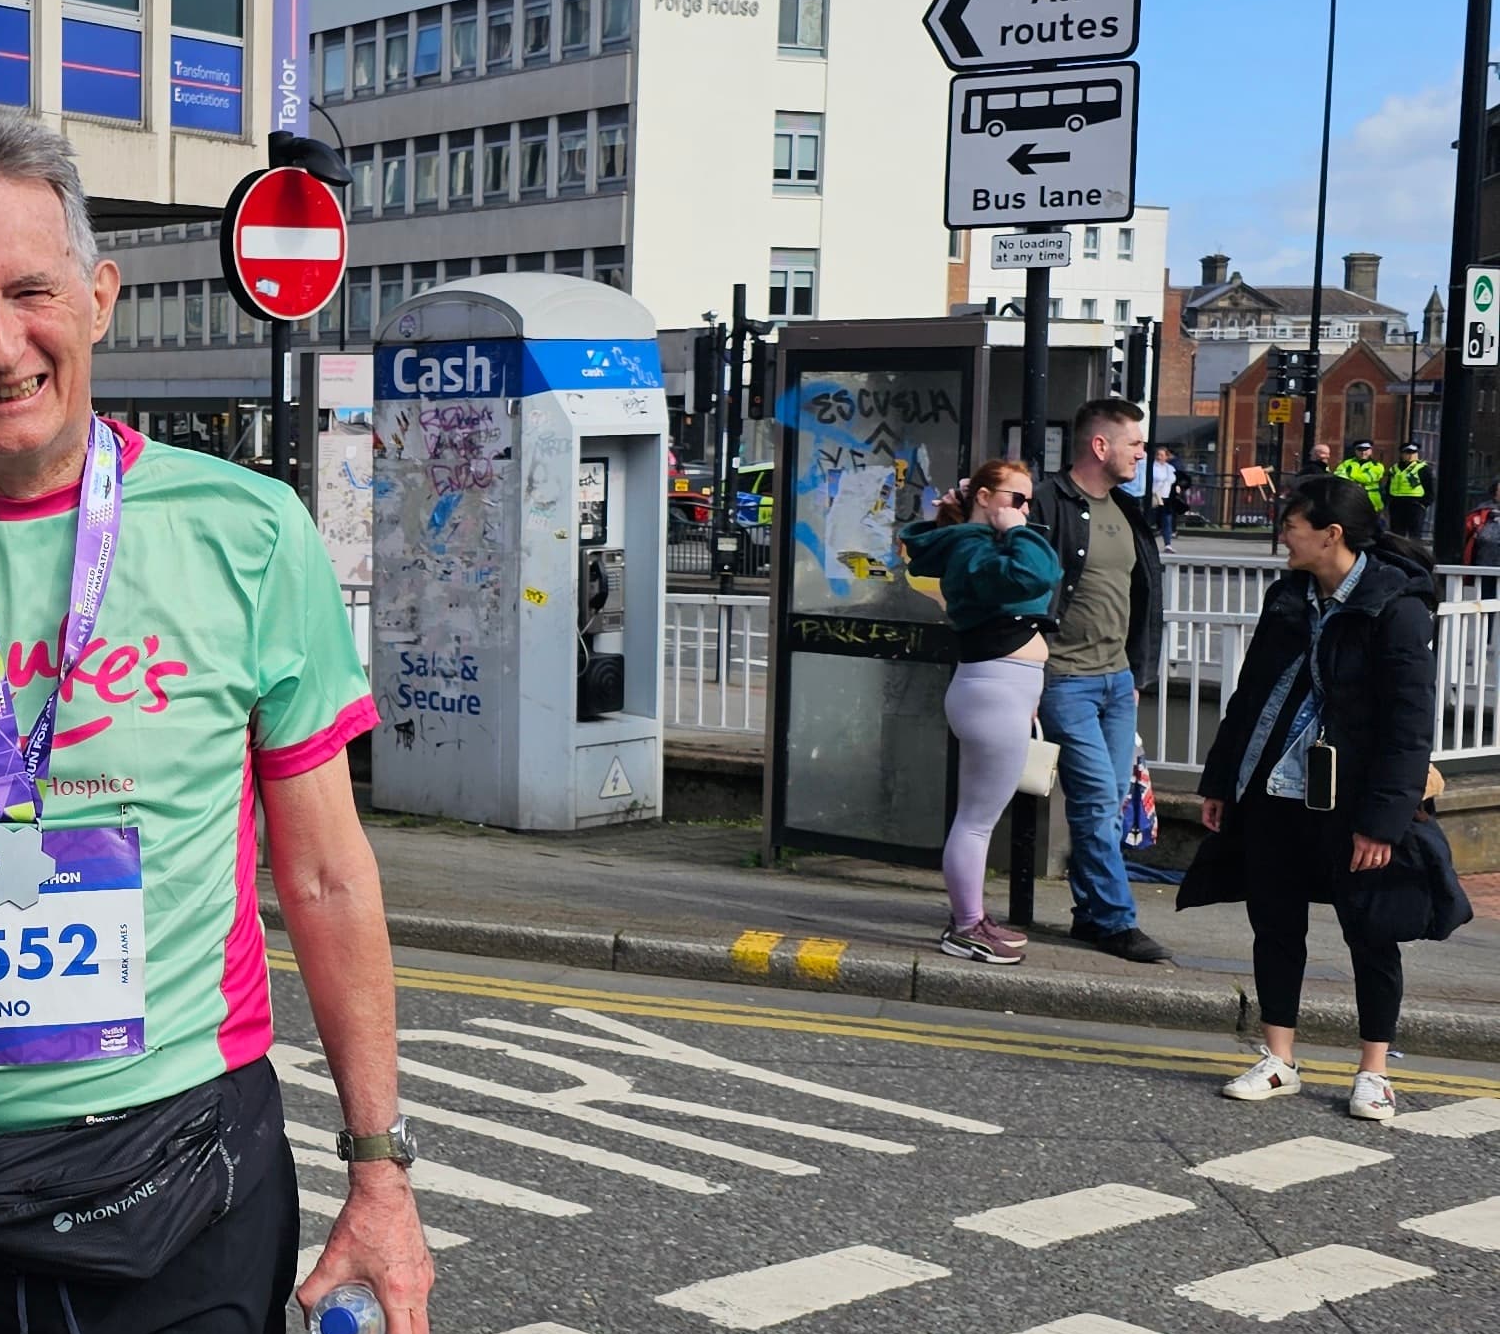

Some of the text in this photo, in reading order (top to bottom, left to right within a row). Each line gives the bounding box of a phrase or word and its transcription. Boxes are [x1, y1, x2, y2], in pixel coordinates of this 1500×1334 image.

[999, 13, 1119, 46] routes
[174, 60, 231, 86] Transforming
[174, 87, 230, 109] Expectations
[278, 59, 301, 130] Taylor
[972, 185, 1102, 211] Bus lane
[995, 251, 1065, 263] at any time
[998, 238, 1063, 250] No loading
[393, 345, 492, 394] Cash
[94, 534, 111, 592] MARATHON
[4, 612, 188, 714] uke's
[460, 655, 479, 682] &
[398, 683, 481, 715] Secure
[33, 722, 49, 749] FOR
[27, 751, 40, 782] RUN
[119, 924, 128, 984] MARK JAMES
[75, 1180, 158, 1224] MONTANE
